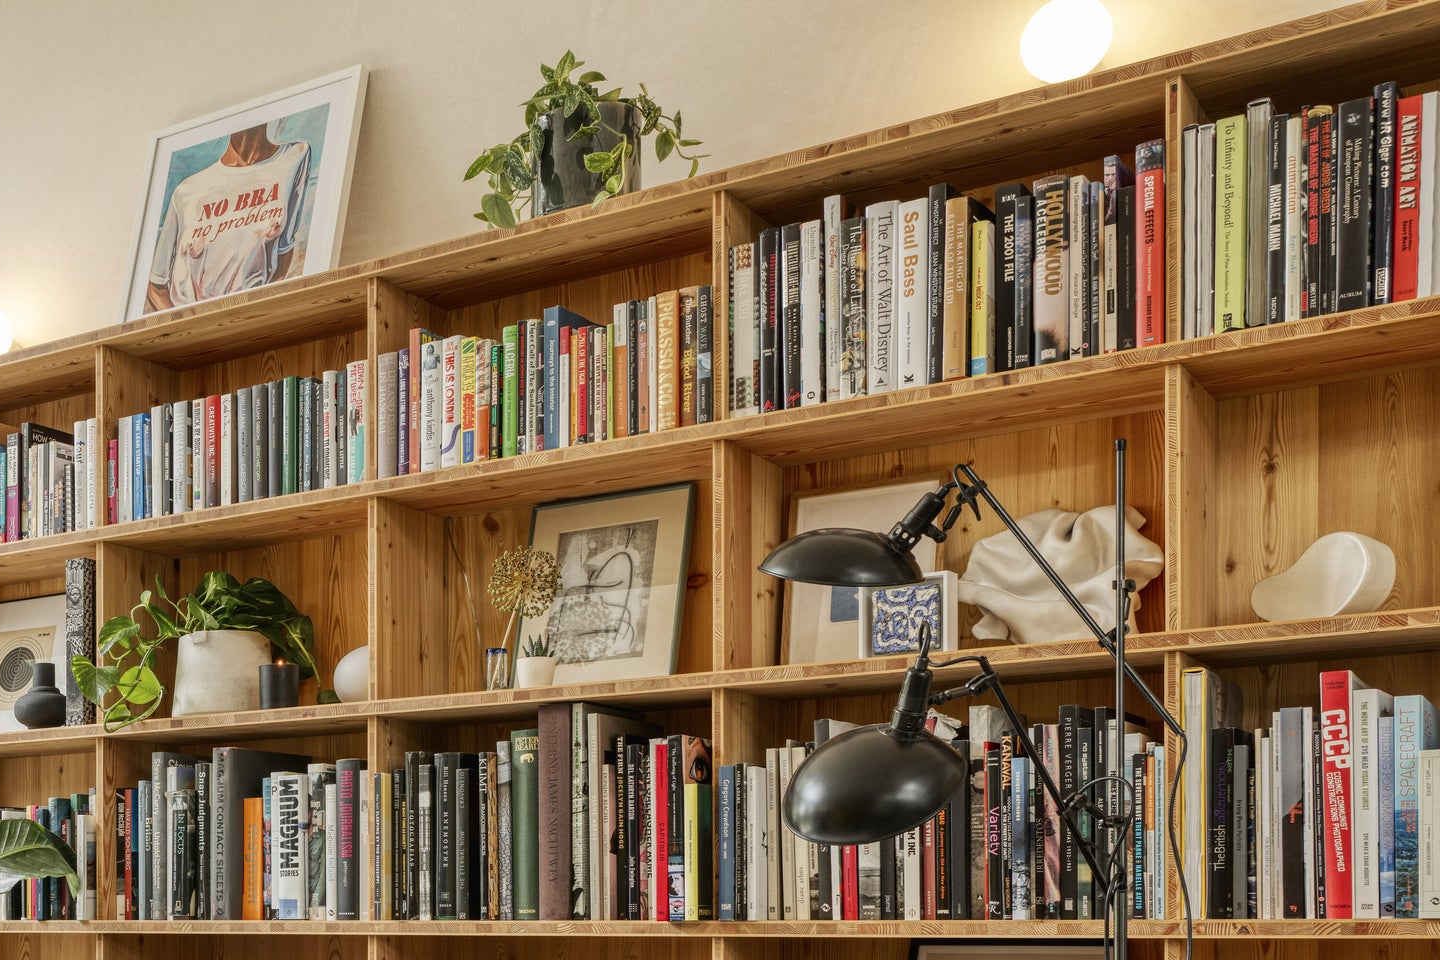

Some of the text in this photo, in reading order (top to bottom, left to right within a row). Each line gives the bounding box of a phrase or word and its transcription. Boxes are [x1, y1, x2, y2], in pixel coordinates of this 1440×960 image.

[1223, 122, 1235, 228] To Infinity and Beyond!
[1288, 155, 1298, 215] animation
[1344, 147, 1352, 175] European
[1399, 115, 1417, 209] ANIMATION ART
[192, 203, 283, 243] no problem
[198, 183, 279, 222] NO BRA
[1269, 184, 1282, 224] MICHAEL
[1342, 176, 1353, 224] Cinematography
[809, 226, 817, 260] Uncredited
[903, 211, 919, 298] Saul Bass
[931, 227, 939, 245] EFFECT
[946, 214, 954, 305] RETURN OF THE JEDI
[956, 221, 964, 293] THE MAKING OF
[1004, 214, 1014, 282] THE 2001 FILE
[1044, 190, 1064, 296] HOLLYWOOD
[1269, 226, 1281, 251] MANN
[849, 225, 862, 314] The Illusion of Life
[874, 211, 893, 372] The Art of Walt Disney
[931, 252, 939, 317] STAN WINSTON STUDIO
[1340, 291, 1363, 300] AURUM
[1377, 270, 1385, 296] TASCHEN
[504, 342, 515, 378] ALGERIA
[548, 339, 556, 368] Journeys
[658, 302, 674, 369] PICASSO
[682, 297, 692, 413] Tim Butcher Blood River
[444, 352, 455, 424] THIS IS LONDON
[462, 355, 475, 392] AFRICA39
[658, 383, 673, 409] CO.
[379, 371, 387, 434] IN SHANGHAI
[425, 389, 436, 441] anthony kiedis
[76, 441, 85, 464] four
[1361, 701, 1369, 712] THE
[1361, 713, 1369, 727] MOVIE
[1361, 727, 1369, 737] ART
[515, 736, 539, 744] PETER
[1002, 736, 1011, 790] KANAVAL
[1064, 717, 1072, 790] PIERRE VERGER
[1321, 708, 1350, 769] CCCP
[1361, 745, 1369, 755] SYD
[1361, 756, 1369, 769] MEAD
[1400, 709, 1417, 796] SPACECRAFT
[153, 758, 161, 816] Steve McCurry
[479, 758, 487, 793] KLIMT
[722, 779, 730, 805] Gregory
[1333, 771, 1348, 831] COSMIC COMMUNIST
[1361, 770, 1369, 787] VISUAL
[1361, 788, 1370, 810] FUTURIST
[1381, 727, 1393, 849] BUILDING FOR TOMORROW
[197, 772, 206, 851] Snap Judgments
[216, 753, 225, 902] MAGNUM CONTACT SHEETS
[279, 779, 299, 869] MAGNUM
[340, 770, 352, 858] PHOTO JOURNALISM
[547, 722, 559, 883] INFERNO JAMES NACHTWEY
[1326, 772, 1345, 872] CONSTRUCTIONS PHOTOGRAPHED
[145, 817, 153, 851] Britain
[153, 831, 161, 858] Untold
[988, 807, 1000, 856] Variety
[1035, 817, 1043, 873] IRREDENTOS
[280, 869, 299, 877] STORIES
